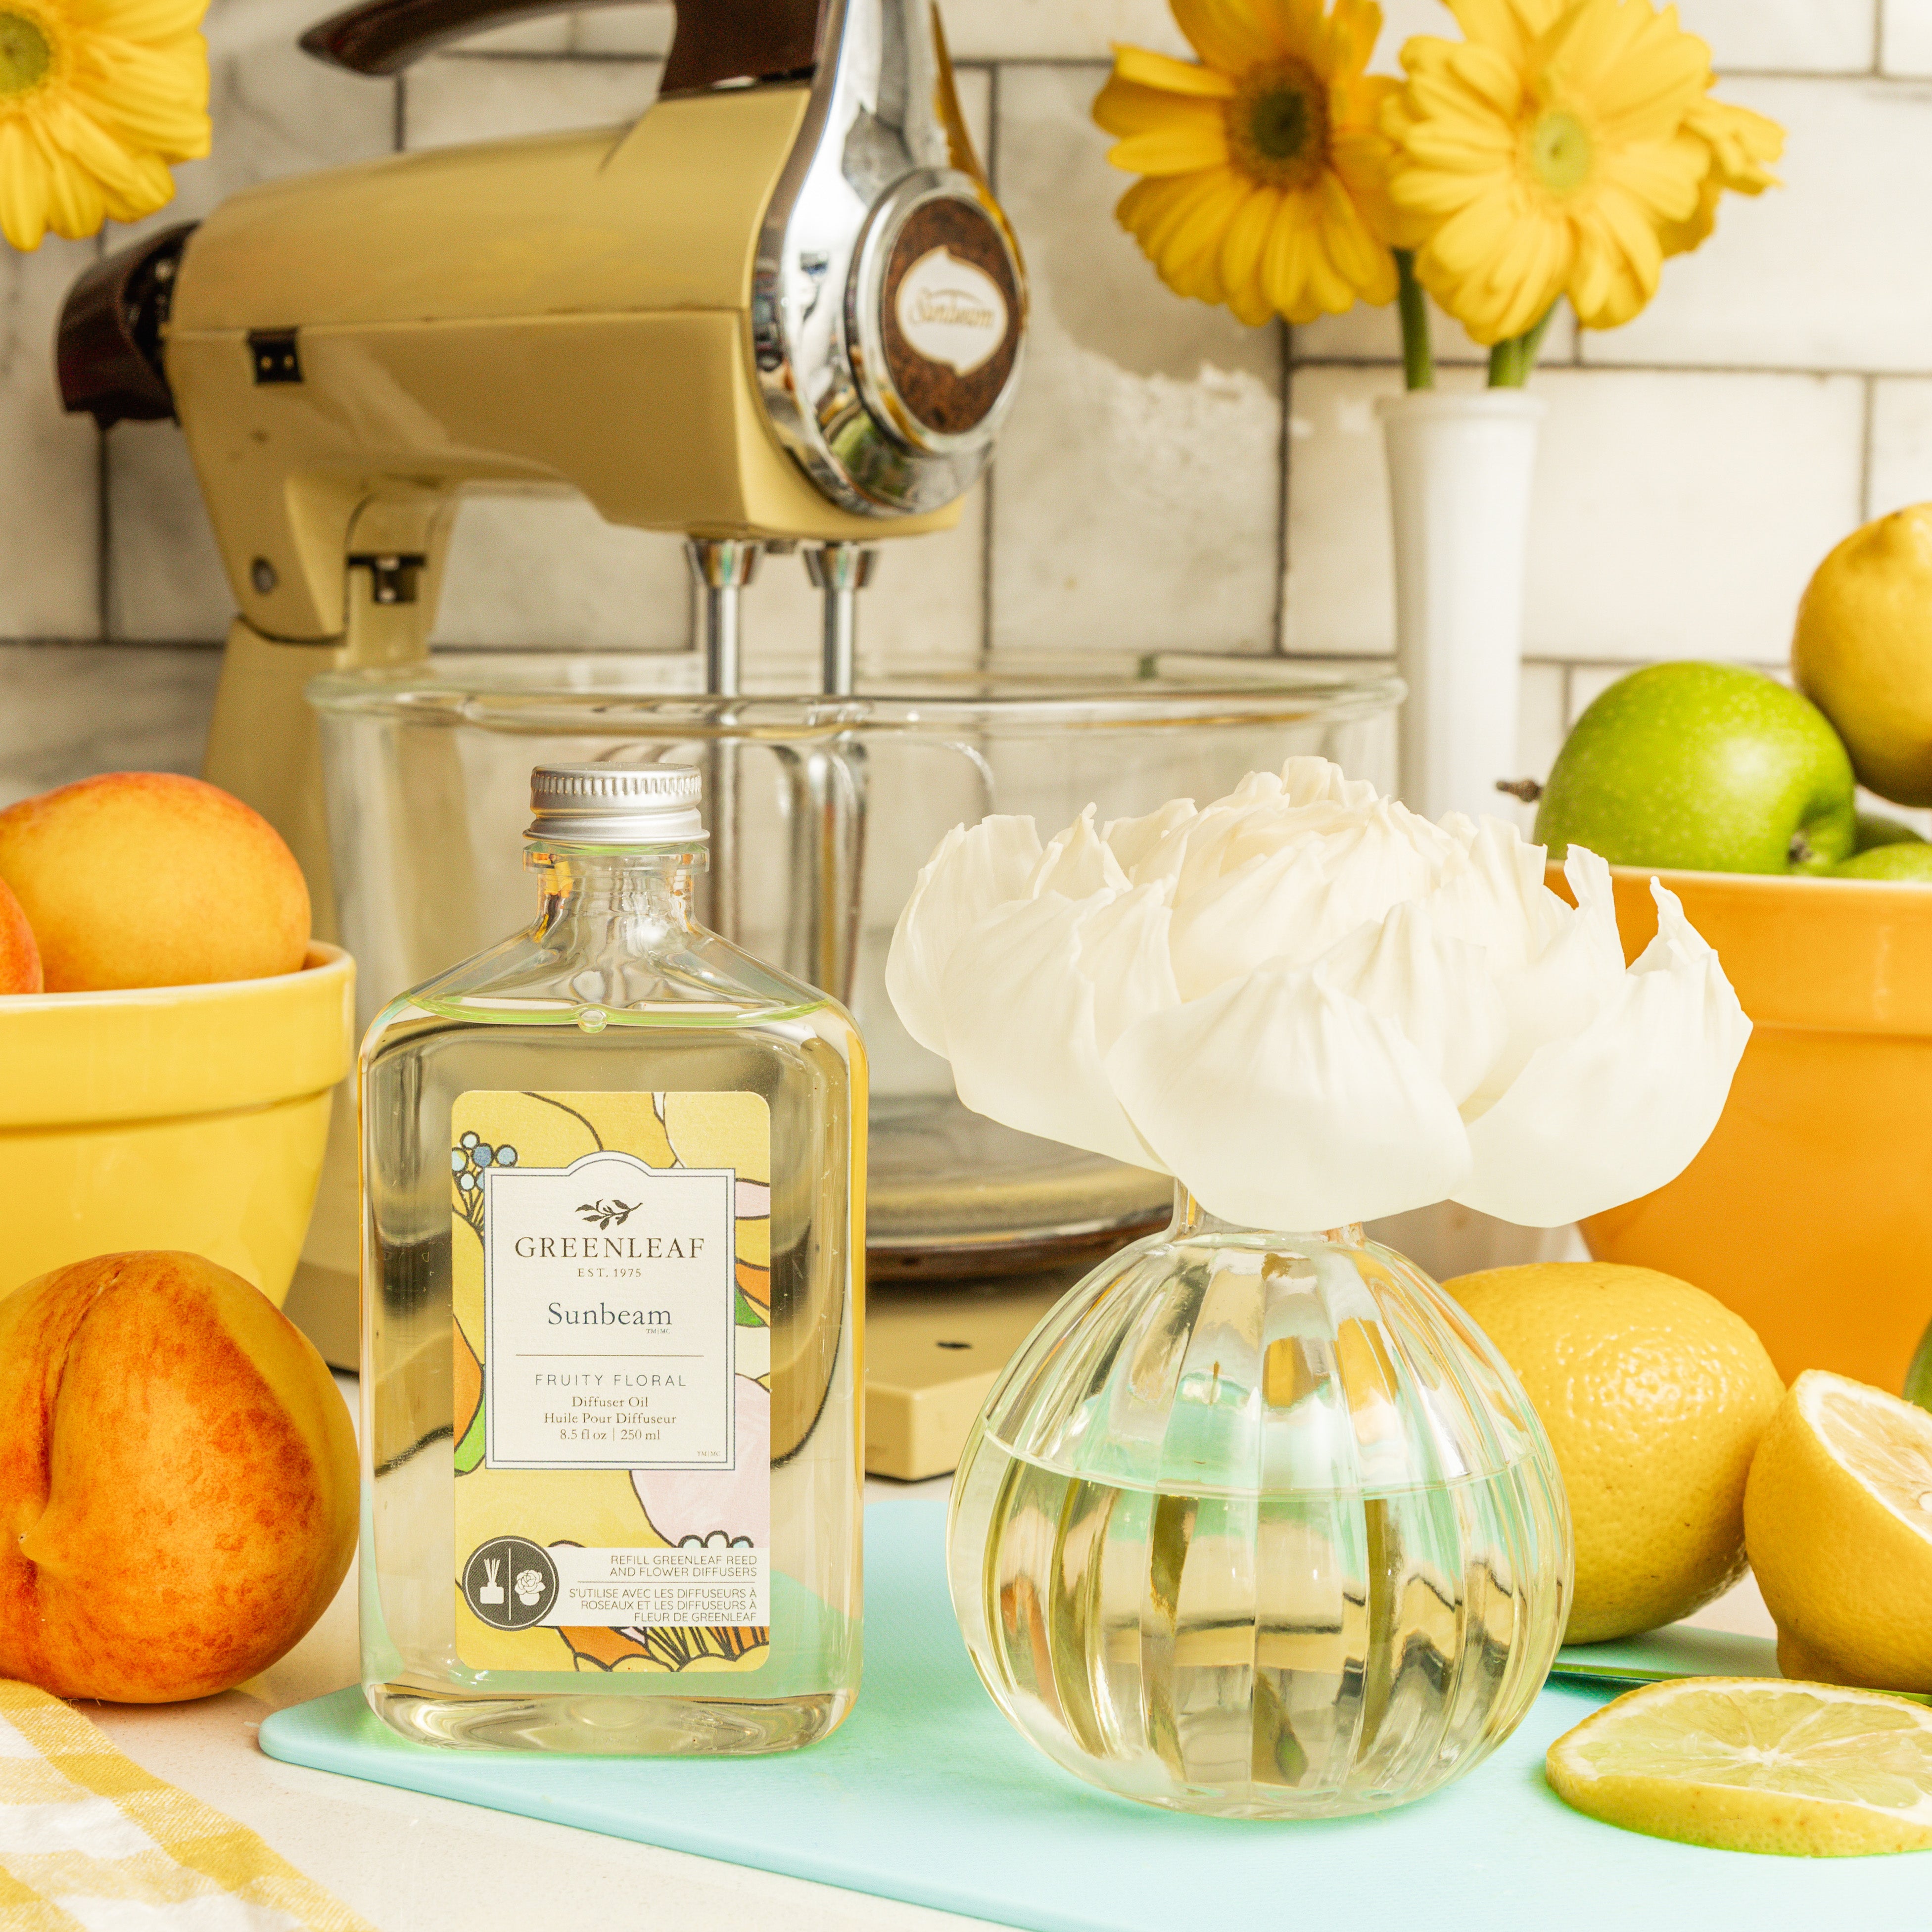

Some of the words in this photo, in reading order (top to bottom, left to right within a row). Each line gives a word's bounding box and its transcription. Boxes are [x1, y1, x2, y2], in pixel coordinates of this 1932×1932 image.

[515, 1237, 705, 1258] GREENLEAF
[578, 1269, 609, 1277] EST.
[613, 1269, 642, 1277] 1975
[548, 1303, 672, 1325] Sunbeam
[536, 1374, 604, 1386] FRUITY
[614, 1374, 686, 1386] FLORAL
[572, 1396, 624, 1408] Diffuser
[628, 1397, 649, 1408] Oil
[545, 1414, 578, 1424] Huile
[583, 1414, 613, 1424] Pour
[616, 1414, 676, 1424] Diffuseur
[560, 1430, 577, 1440] 8.5
[581, 1429, 591, 1440] fl
[621, 1429, 642, 1440] 250
[645, 1429, 660, 1440] ml
[611, 1555, 650, 1565] REFILL
[653, 1555, 722, 1565] GREENLEAF
[727, 1555, 756, 1565] REED
[610, 1567, 636, 1577] AND
[640, 1567, 689, 1577] FLOWER
[693, 1567, 756, 1577] DIFFUSERS
[622, 1589, 651, 1598] AVEC
[655, 1589, 674, 1598] LES
[677, 1589, 746, 1598] DIFFUSEURS
[750, 1587, 756, 1598] À
[581, 1601, 634, 1610] ROSEAUX
[638, 1601, 651, 1610] ET
[655, 1601, 673, 1610] LES
[677, 1601, 746, 1610] DIFFUSEURS
[749, 1599, 756, 1610] À
[634, 1612, 670, 1622] FLEUR
[673, 1612, 688, 1622] DE
[692, 1612, 756, 1622] GREENLEAF
